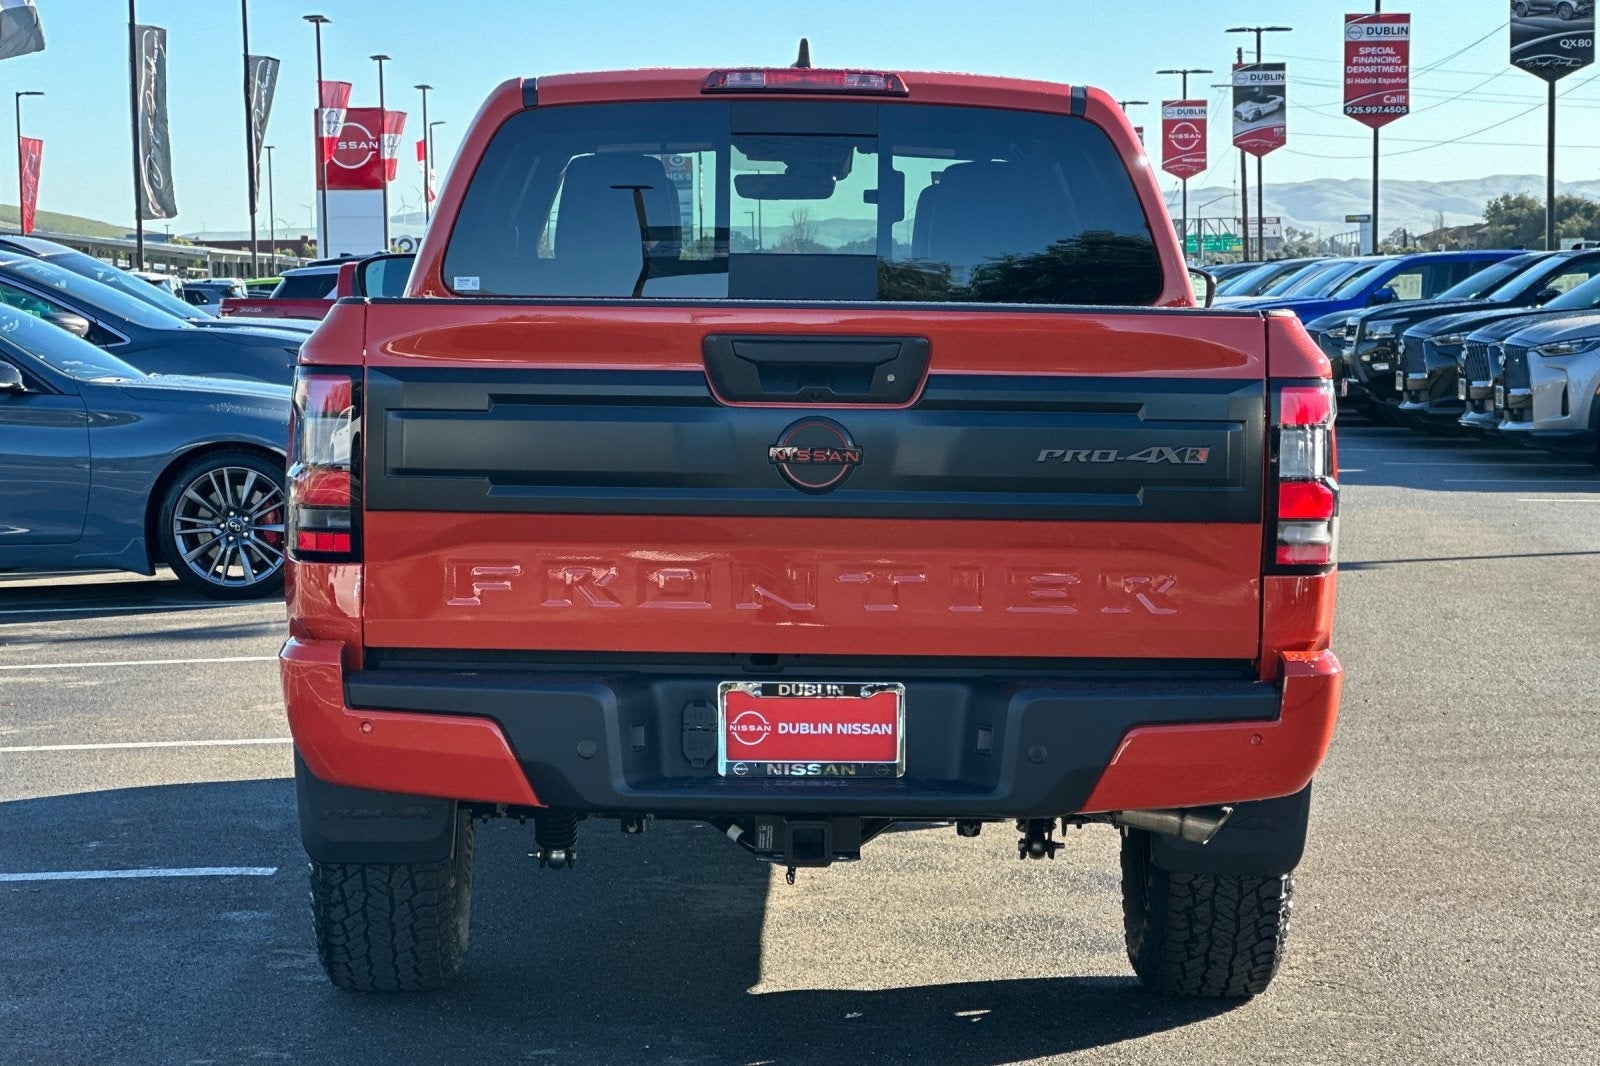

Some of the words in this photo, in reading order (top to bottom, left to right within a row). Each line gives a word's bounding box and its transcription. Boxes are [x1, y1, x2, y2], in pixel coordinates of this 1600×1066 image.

[1366, 26, 1409, 36] DUBLIN
[1560, 38, 1592, 49] QX80
[1358, 46, 1396, 55] SPECIAL
[1352, 56, 1402, 64] FINANCING
[1346, 65, 1408, 74] DEPARTMENT
[1355, 76, 1377, 84] Habla
[1378, 77, 1408, 86] Español
[1383, 95, 1406, 104] Call!
[1346, 106, 1408, 114] 925.997.4505
[337, 141, 379, 150] SSAN
[771, 447, 860, 462] NISSAN
[445, 561, 1180, 616] FRONTIER
[777, 683, 845, 697] DUBLIN
[729, 724, 771, 732] NISSAN
[778, 722, 833, 735] DUBLIN
[837, 723, 892, 735] NISSAN
[766, 763, 856, 775] NISSAN
